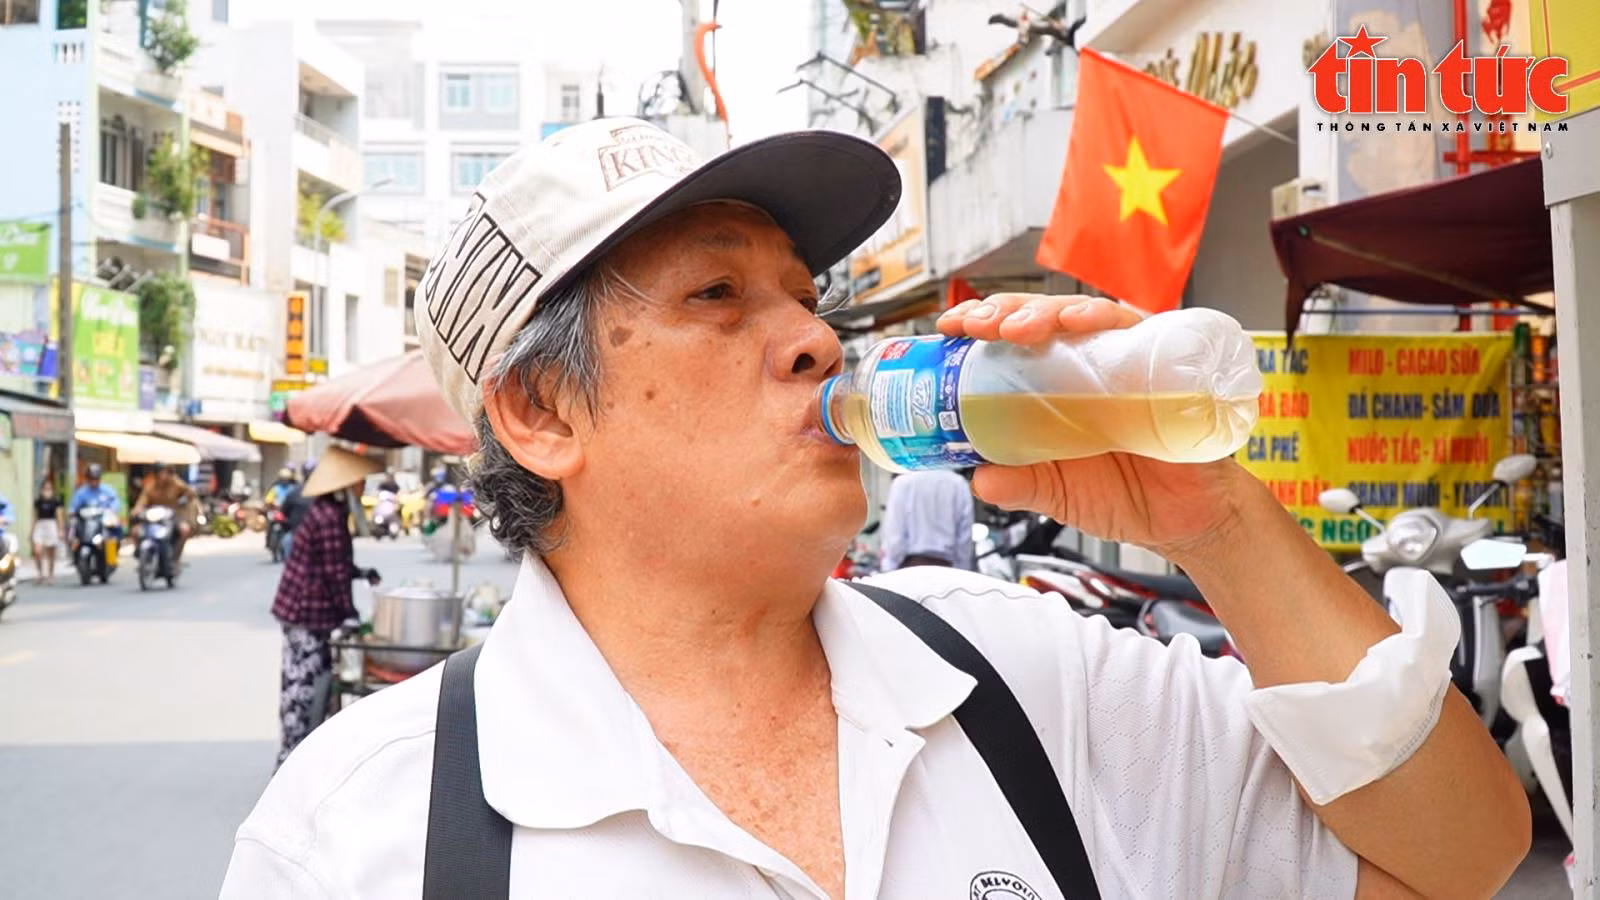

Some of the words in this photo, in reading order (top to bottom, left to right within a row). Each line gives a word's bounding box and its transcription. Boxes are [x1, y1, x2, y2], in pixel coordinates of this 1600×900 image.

[1349, 348, 1384, 375] MILO
[1397, 348, 1447, 375] CACAO
[1271, 431, 1299, 462] PHÊ
